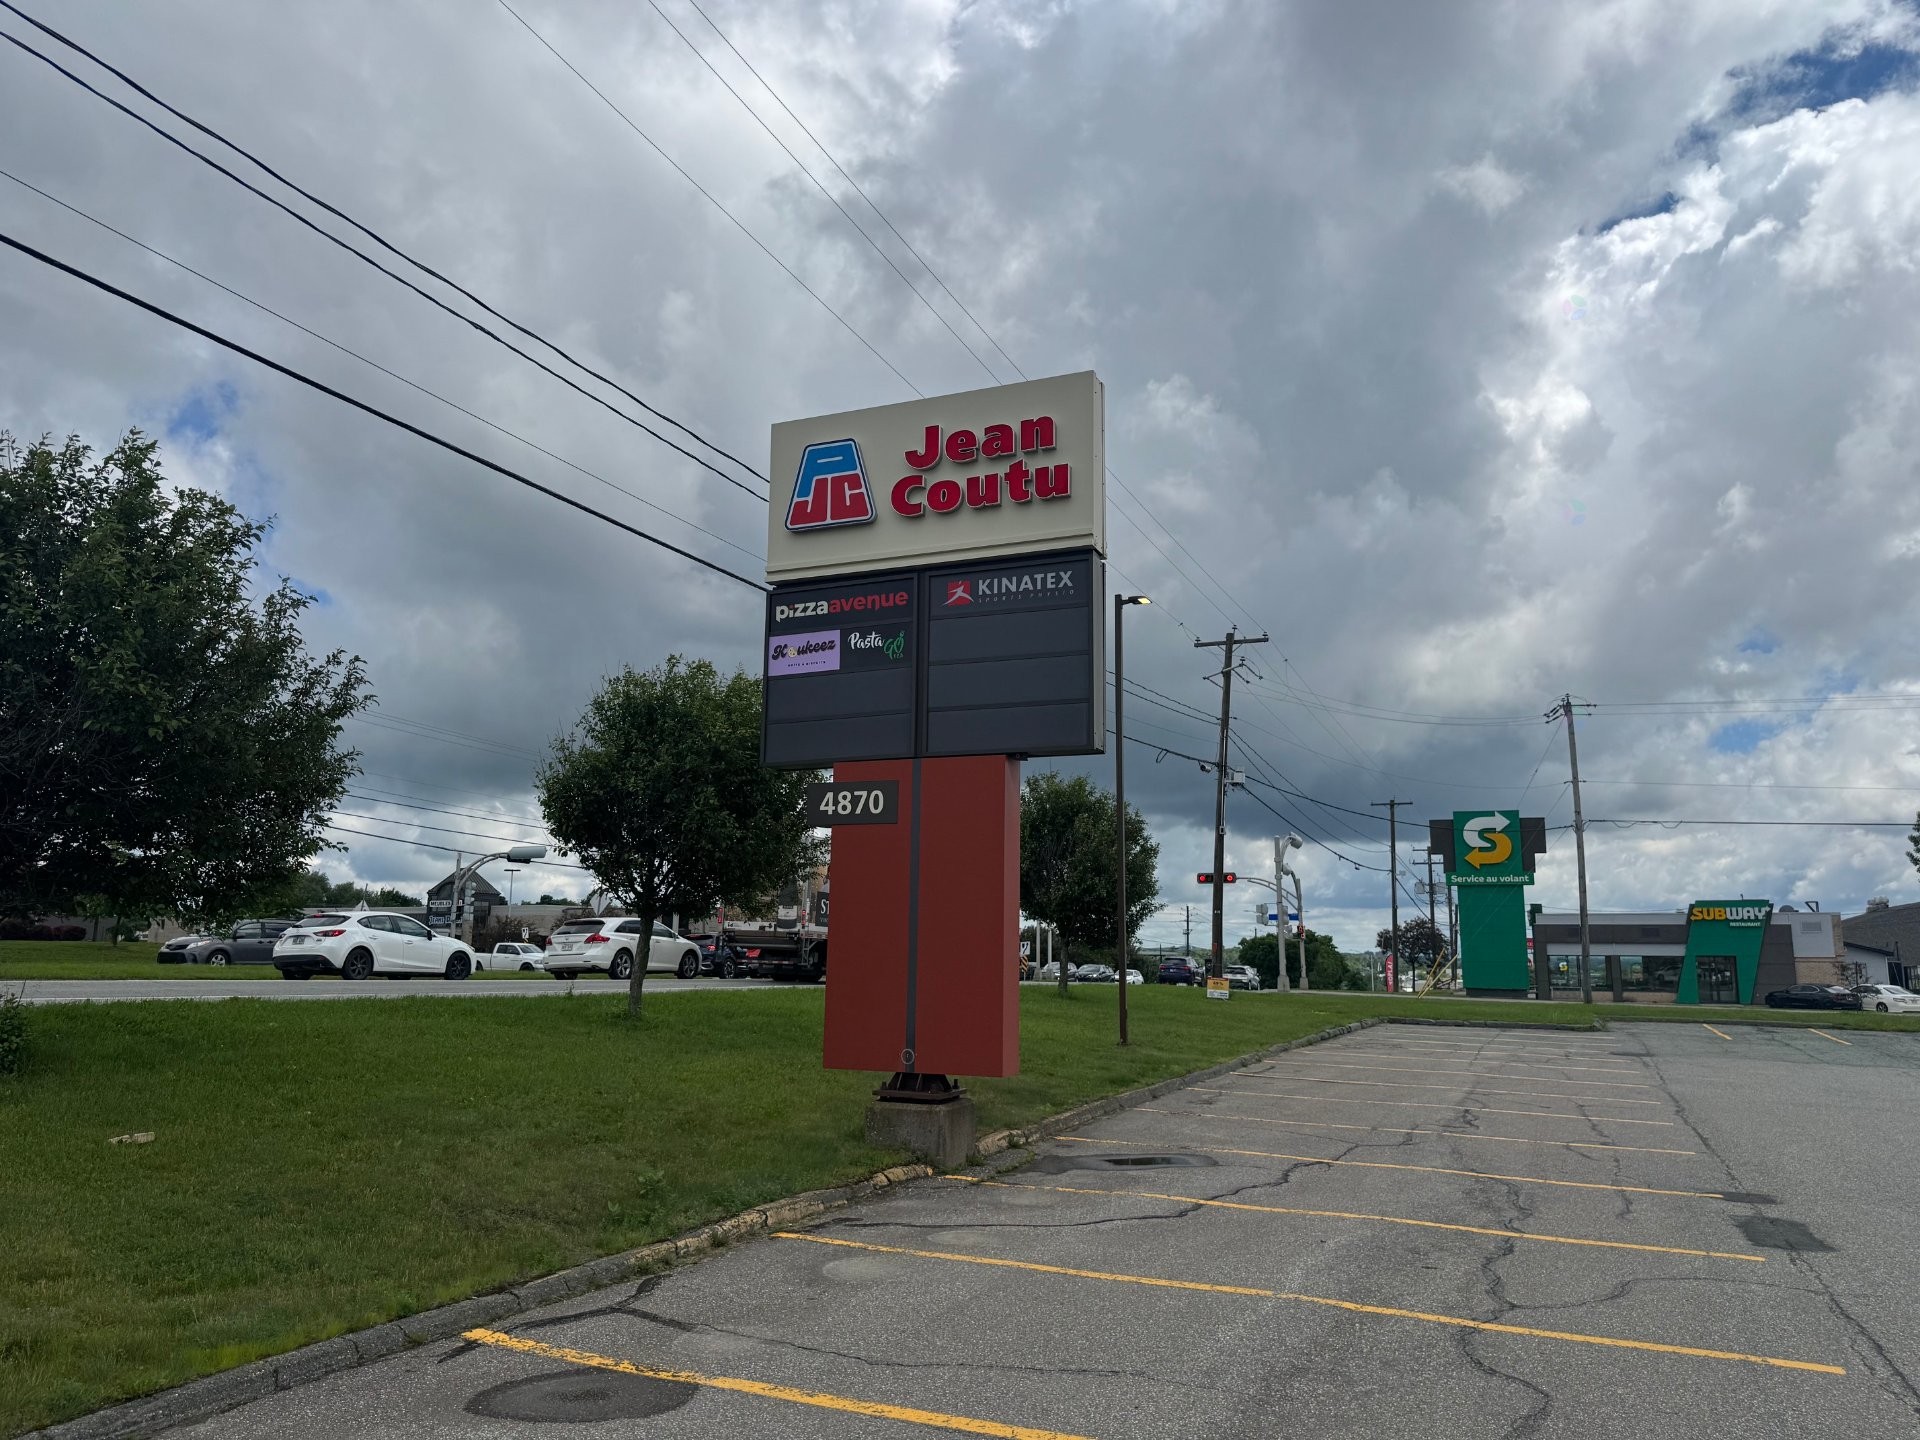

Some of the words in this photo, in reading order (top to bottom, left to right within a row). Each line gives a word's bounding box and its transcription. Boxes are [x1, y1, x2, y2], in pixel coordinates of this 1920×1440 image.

[904, 415, 1057, 470] Jean
[890, 459, 1071, 518] Coutu
[978, 571, 1073, 595] KINATEX
[848, 631, 883, 650] Pasta
[819, 790, 884, 816] 4870
[1451, 874, 1484, 883] Service
[1499, 874, 1530, 882] volant
[1690, 906, 1771, 921] SUBWAY
